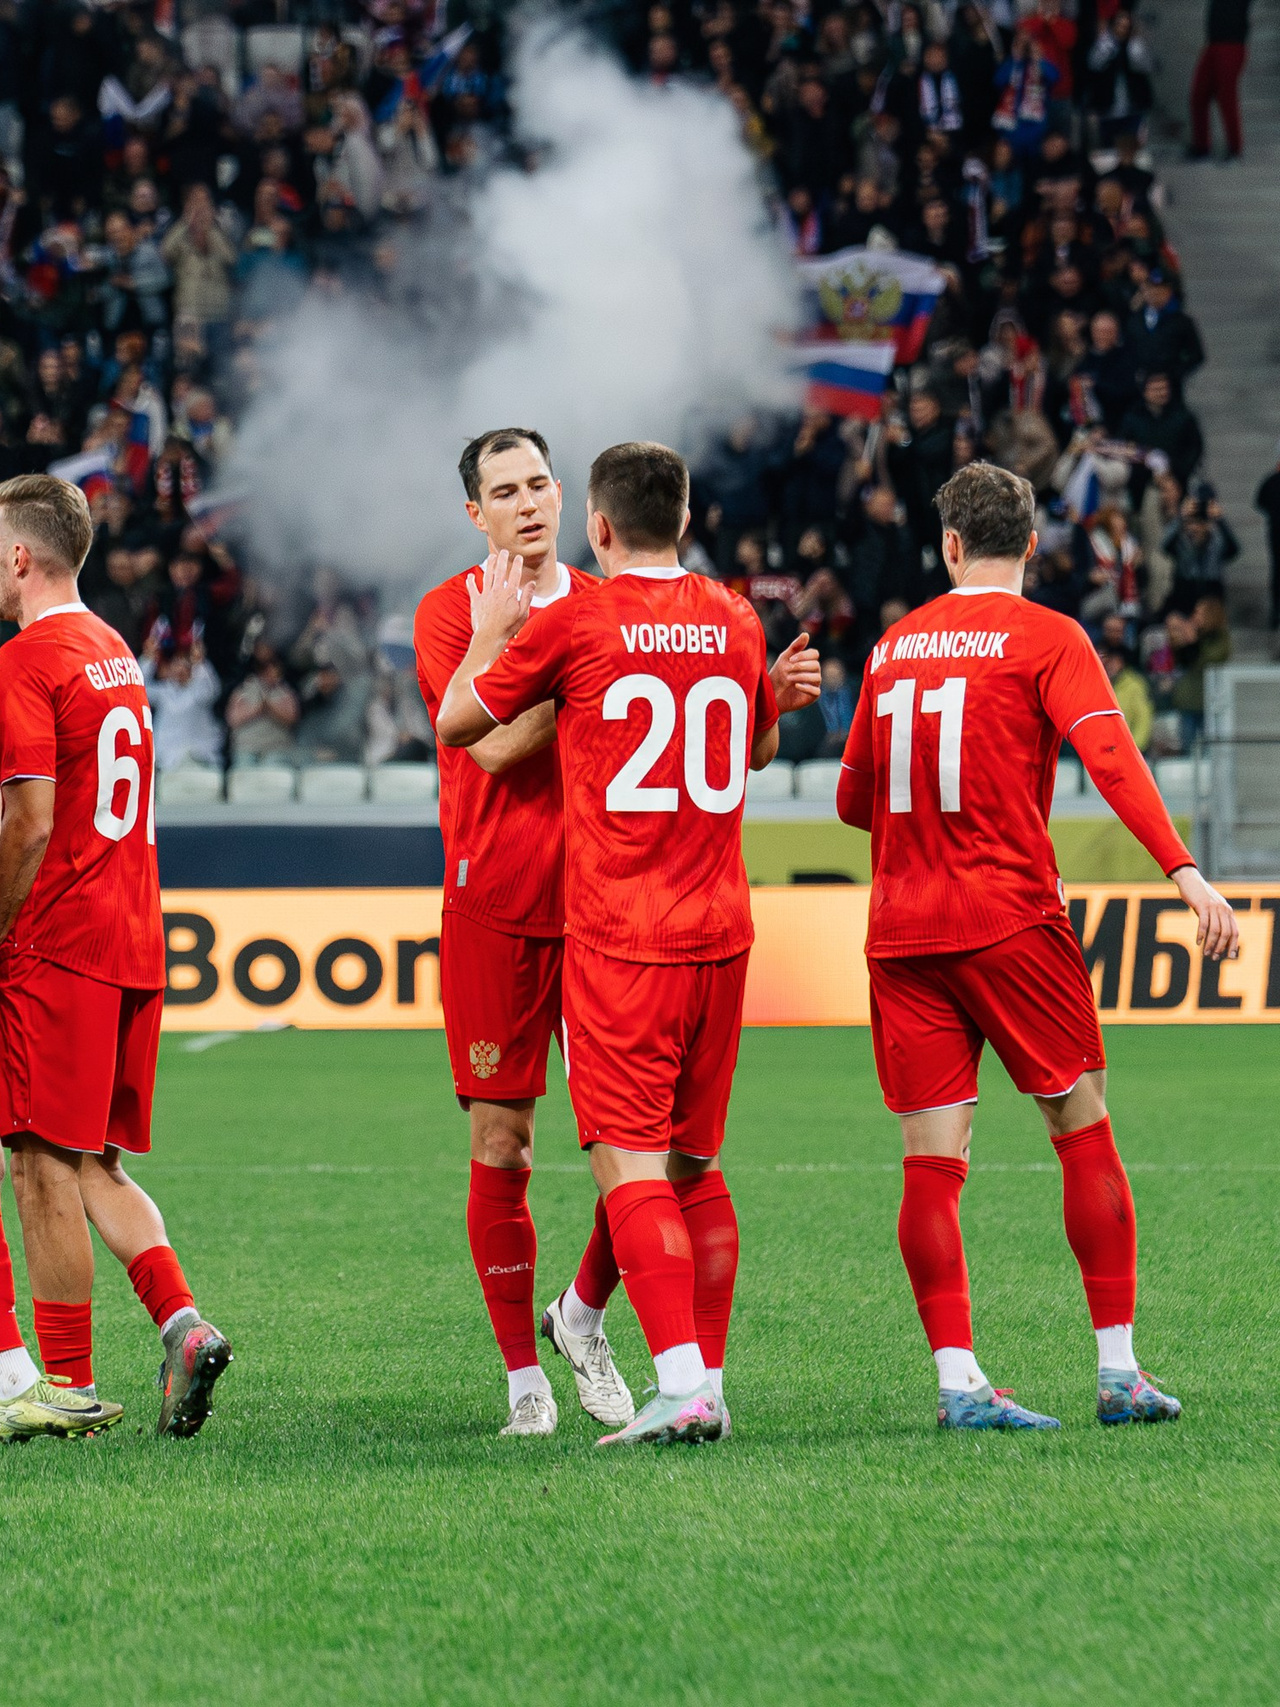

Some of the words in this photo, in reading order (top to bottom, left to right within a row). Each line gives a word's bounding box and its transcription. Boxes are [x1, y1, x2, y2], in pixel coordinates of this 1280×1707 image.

[620, 623, 727, 654] VOROBEV
[892, 631, 1010, 660] MIRANCHUK
[602, 673, 748, 814] 20
[877, 677, 967, 814] 11
